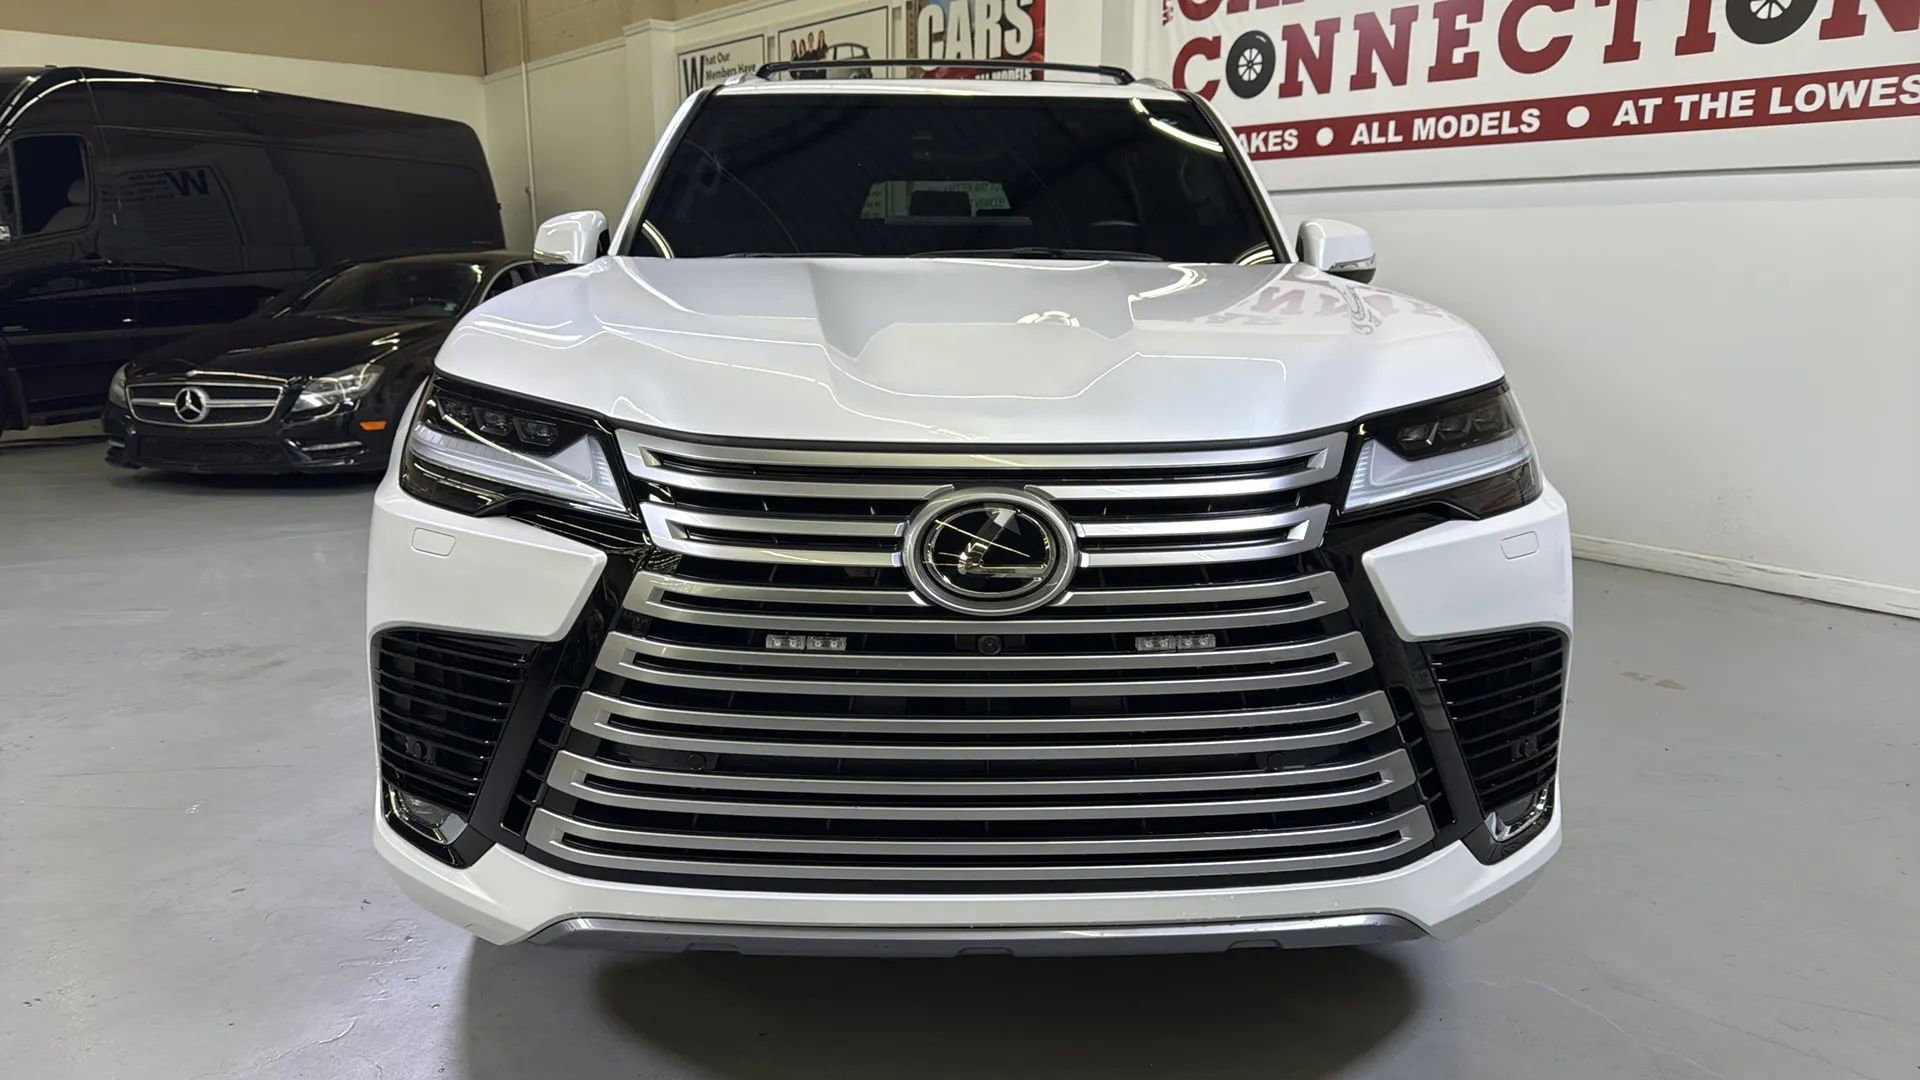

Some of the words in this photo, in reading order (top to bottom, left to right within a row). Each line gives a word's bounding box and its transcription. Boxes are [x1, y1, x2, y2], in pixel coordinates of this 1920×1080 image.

[917, 0, 1034, 72] CARS
[1351, 120, 1403, 146] ALL
[1412, 107, 1541, 142] MODELS
[1612, 97, 1663, 127] AT
[1674, 88, 1757, 122] THE
